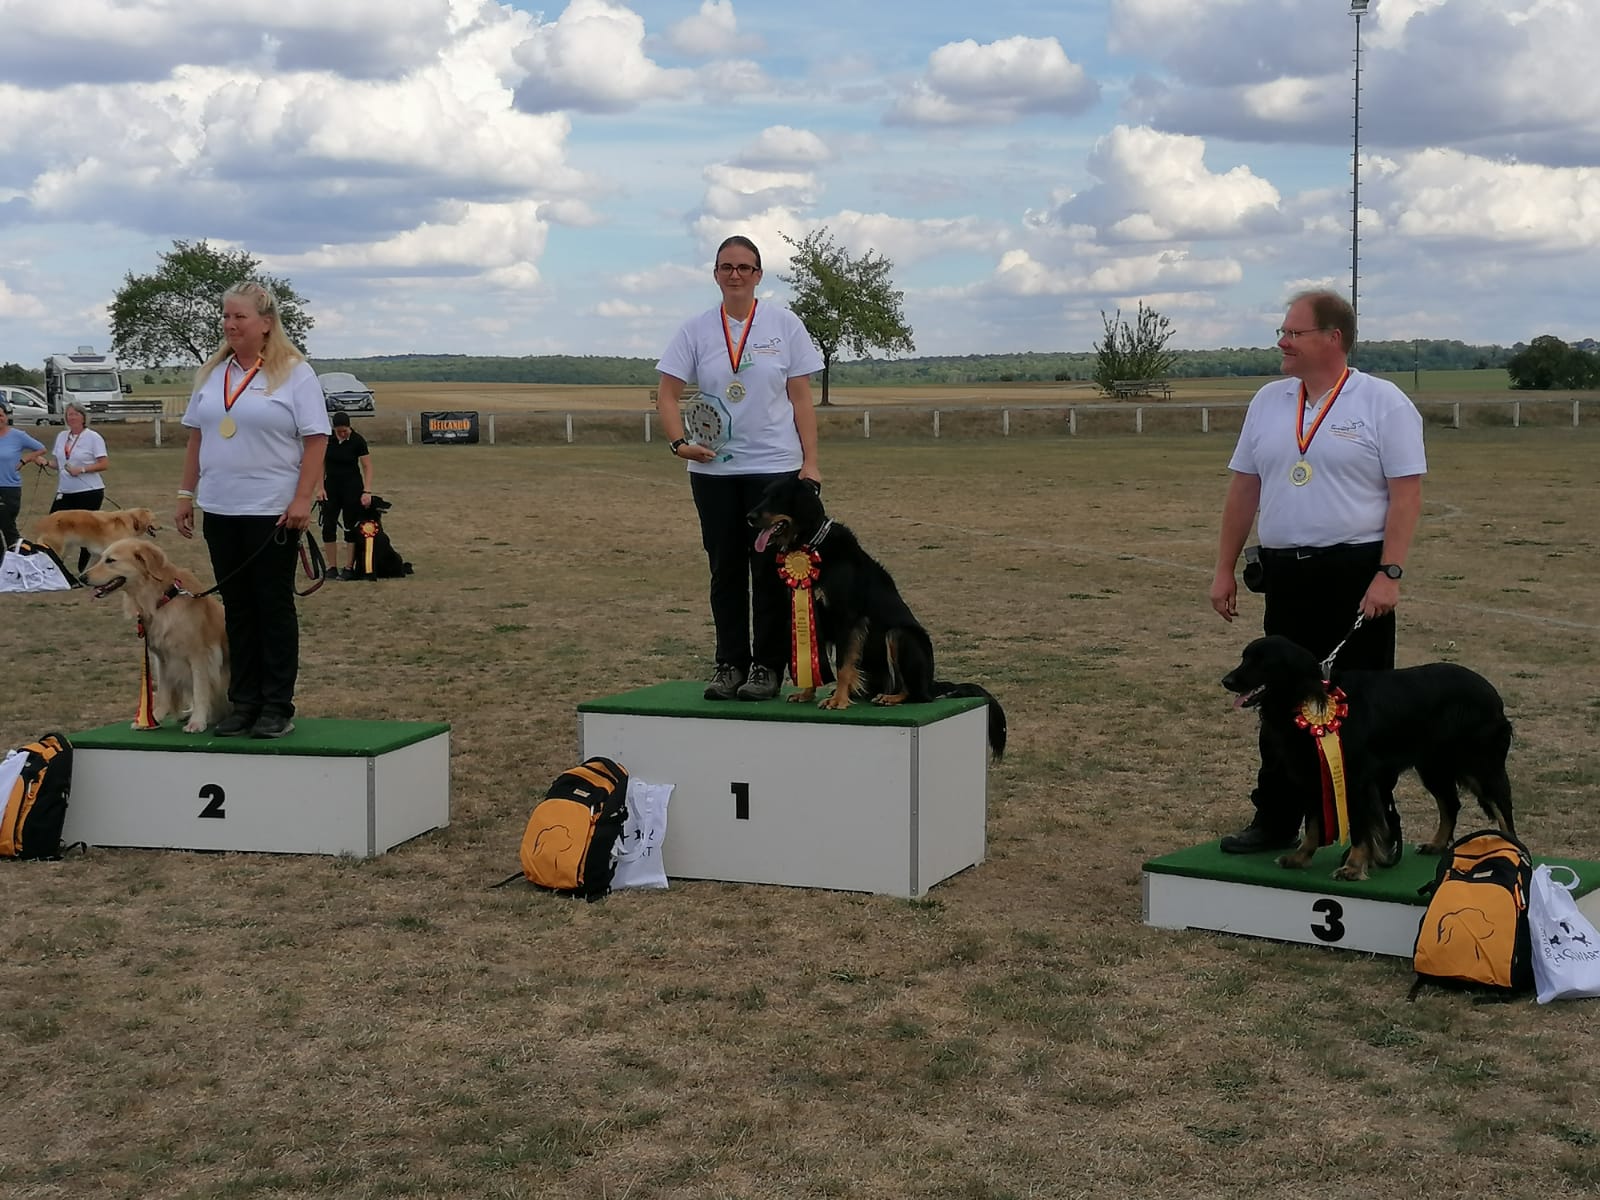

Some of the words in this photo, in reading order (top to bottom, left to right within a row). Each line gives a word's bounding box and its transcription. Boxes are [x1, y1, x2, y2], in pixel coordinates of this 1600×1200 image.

[197, 784, 226, 819] 2
[730, 782, 749, 820] 1
[1310, 898, 1346, 943] 3
